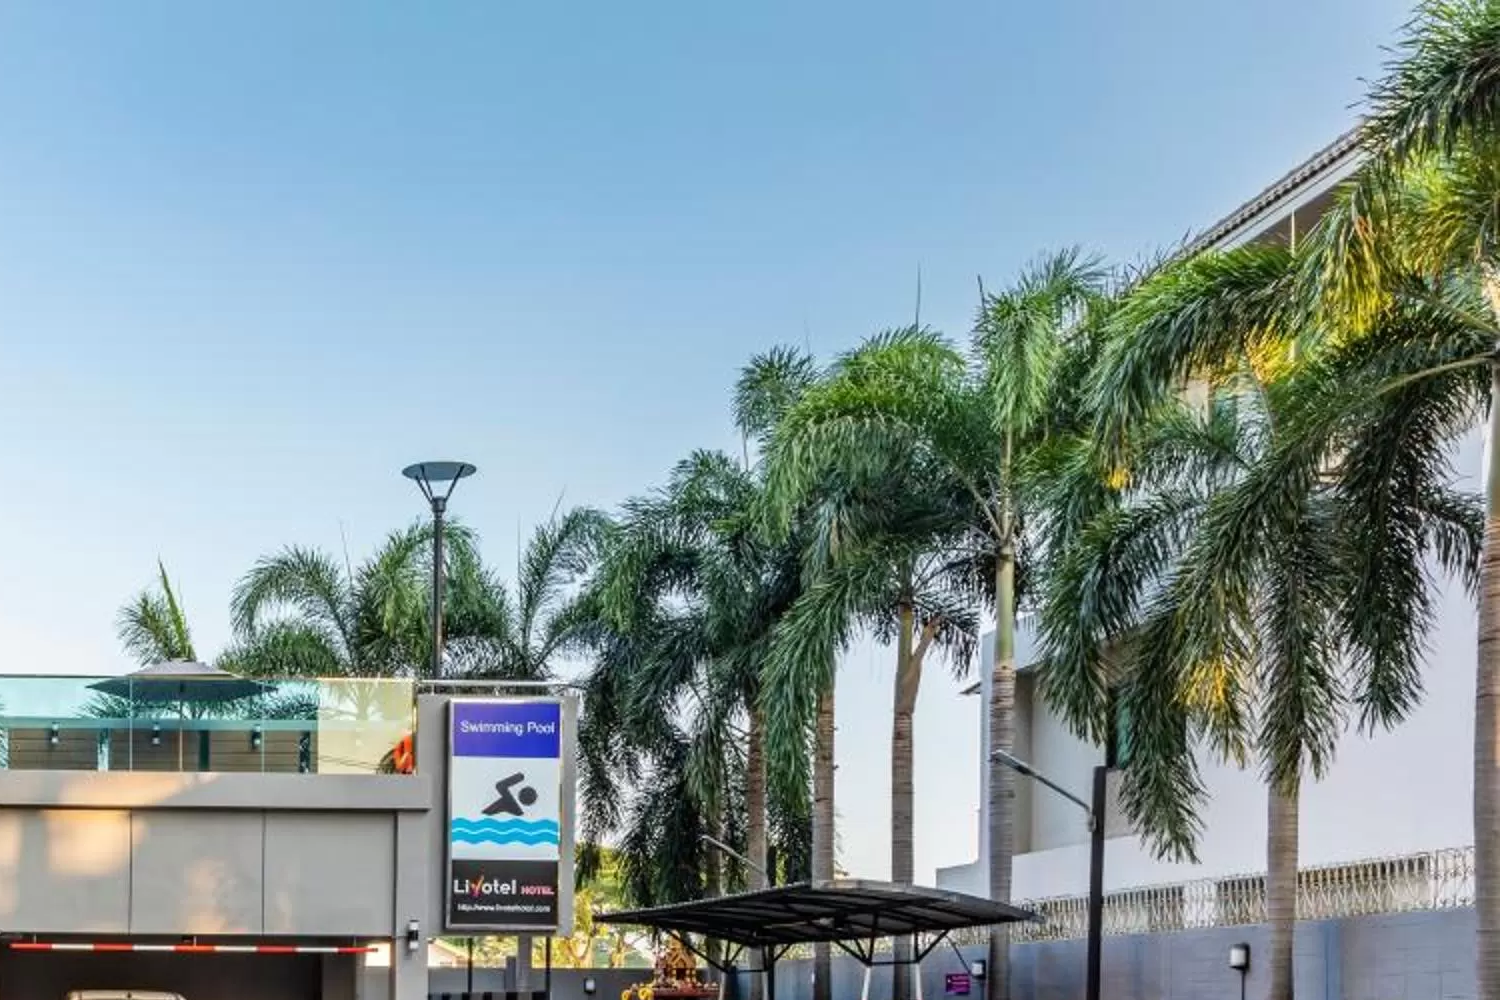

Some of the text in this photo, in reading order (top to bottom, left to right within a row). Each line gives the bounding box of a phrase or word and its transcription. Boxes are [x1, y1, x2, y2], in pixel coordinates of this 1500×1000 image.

[460, 719, 555, 736] Swimming Pool
[521, 885, 555, 896] HOTEL
